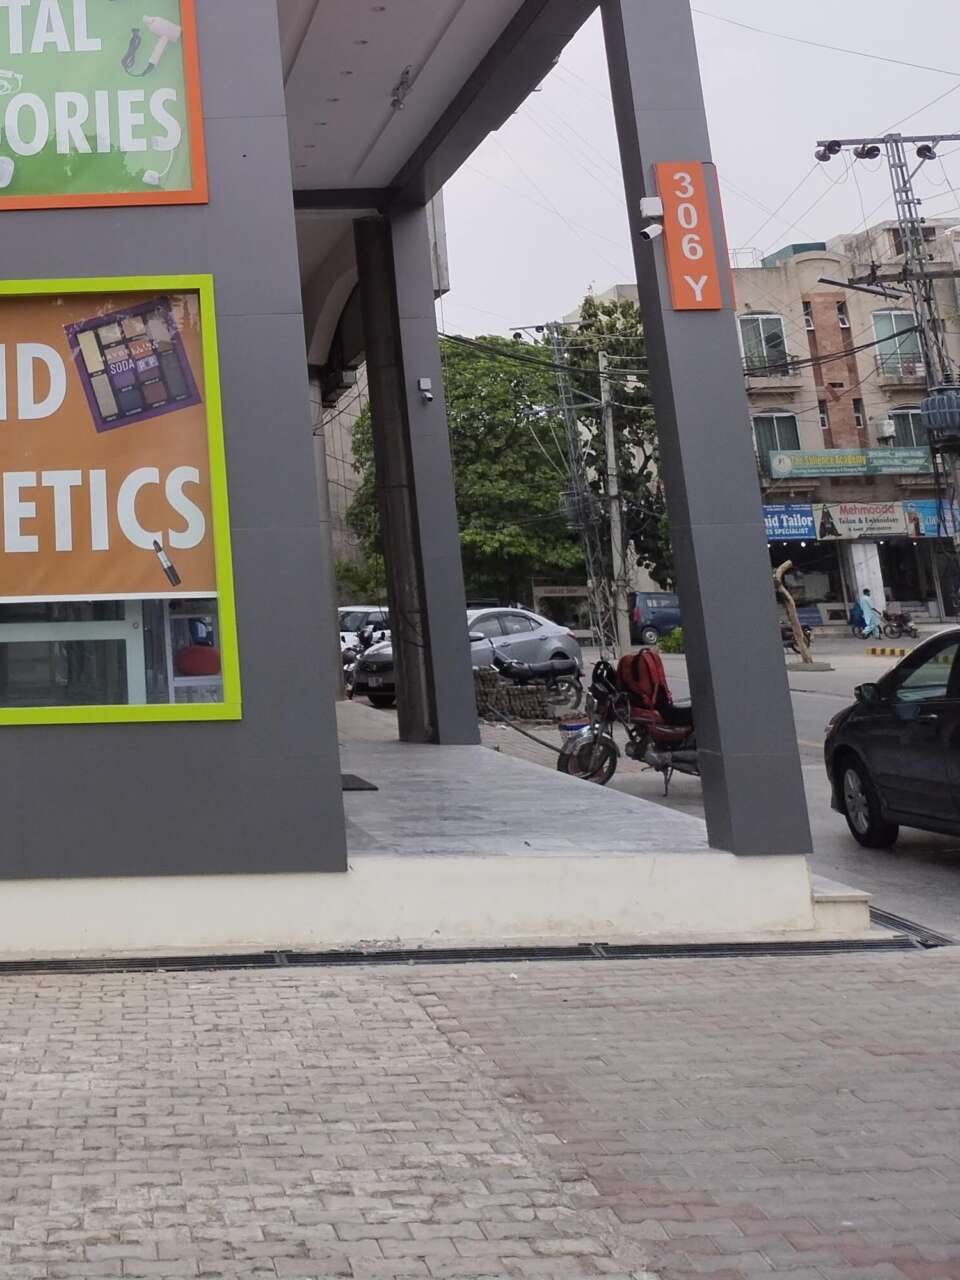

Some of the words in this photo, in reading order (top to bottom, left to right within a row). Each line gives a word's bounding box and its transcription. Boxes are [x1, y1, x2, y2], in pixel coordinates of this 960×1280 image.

[683, 274, 709, 302] Y
[109, 357, 136, 376] SODA
[780, 513, 813, 527] Tailor
[774, 527, 809, 536] SPECIALIST
